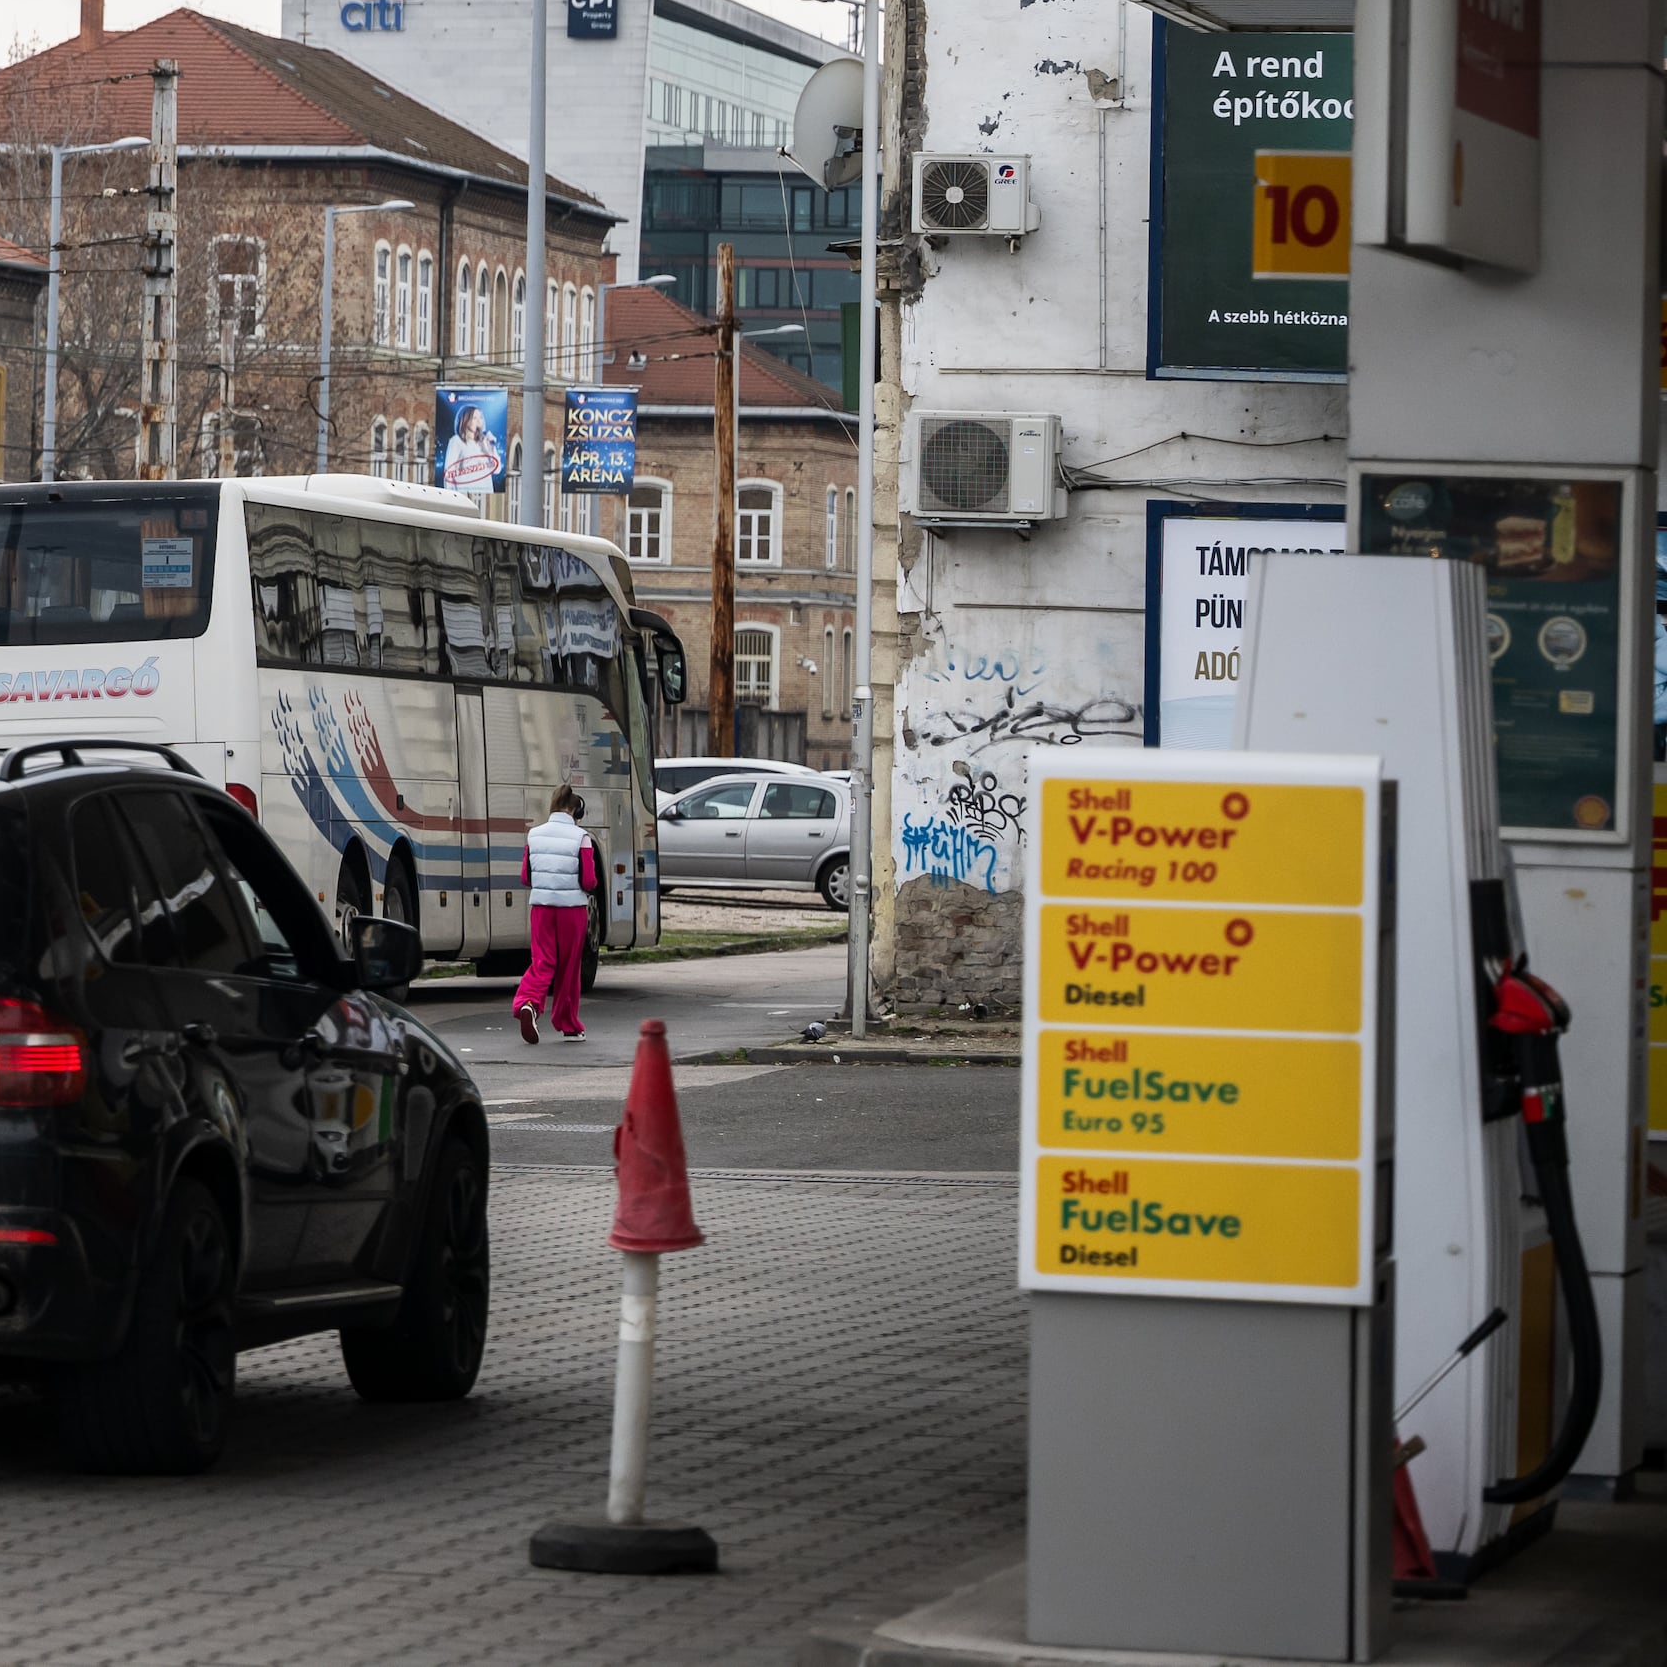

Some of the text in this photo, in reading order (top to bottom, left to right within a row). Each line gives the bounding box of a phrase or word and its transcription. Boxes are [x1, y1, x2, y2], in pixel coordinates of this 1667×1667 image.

[582, 11, 612, 21] Property
[591, 21, 612, 30] Group
[1212, 51, 1323, 79] A rend
[1265, 184, 1340, 248] 10
[1208, 310, 1220, 323] A
[1224, 310, 1269, 325] szebb
[568, 408, 634, 425] KONCZ
[567, 425, 636, 442] ZSUZSA
[569, 447, 627, 466] ÁPR. 13.
[568, 464, 625, 483] ARÉNA
[1195, 646, 1241, 681] ADÓ
[1067, 788, 1132, 812] Shell
[1068, 816, 1238, 851] V-Power
[1065, 856, 1218, 887] Racing 100
[1065, 914, 1130, 938] Shell
[1067, 941, 1241, 976] V-Power
[1064, 983, 1145, 1009] Diesel
[1064, 1041, 1128, 1064] Shell
[1062, 1068, 1240, 1105] FuelSave
[1061, 1111, 1166, 1135] Euro 95
[1062, 1172, 1129, 1196] Shell
[1060, 1200, 1242, 1239] FuelSave
[1059, 1245, 1139, 1268] Diesel
